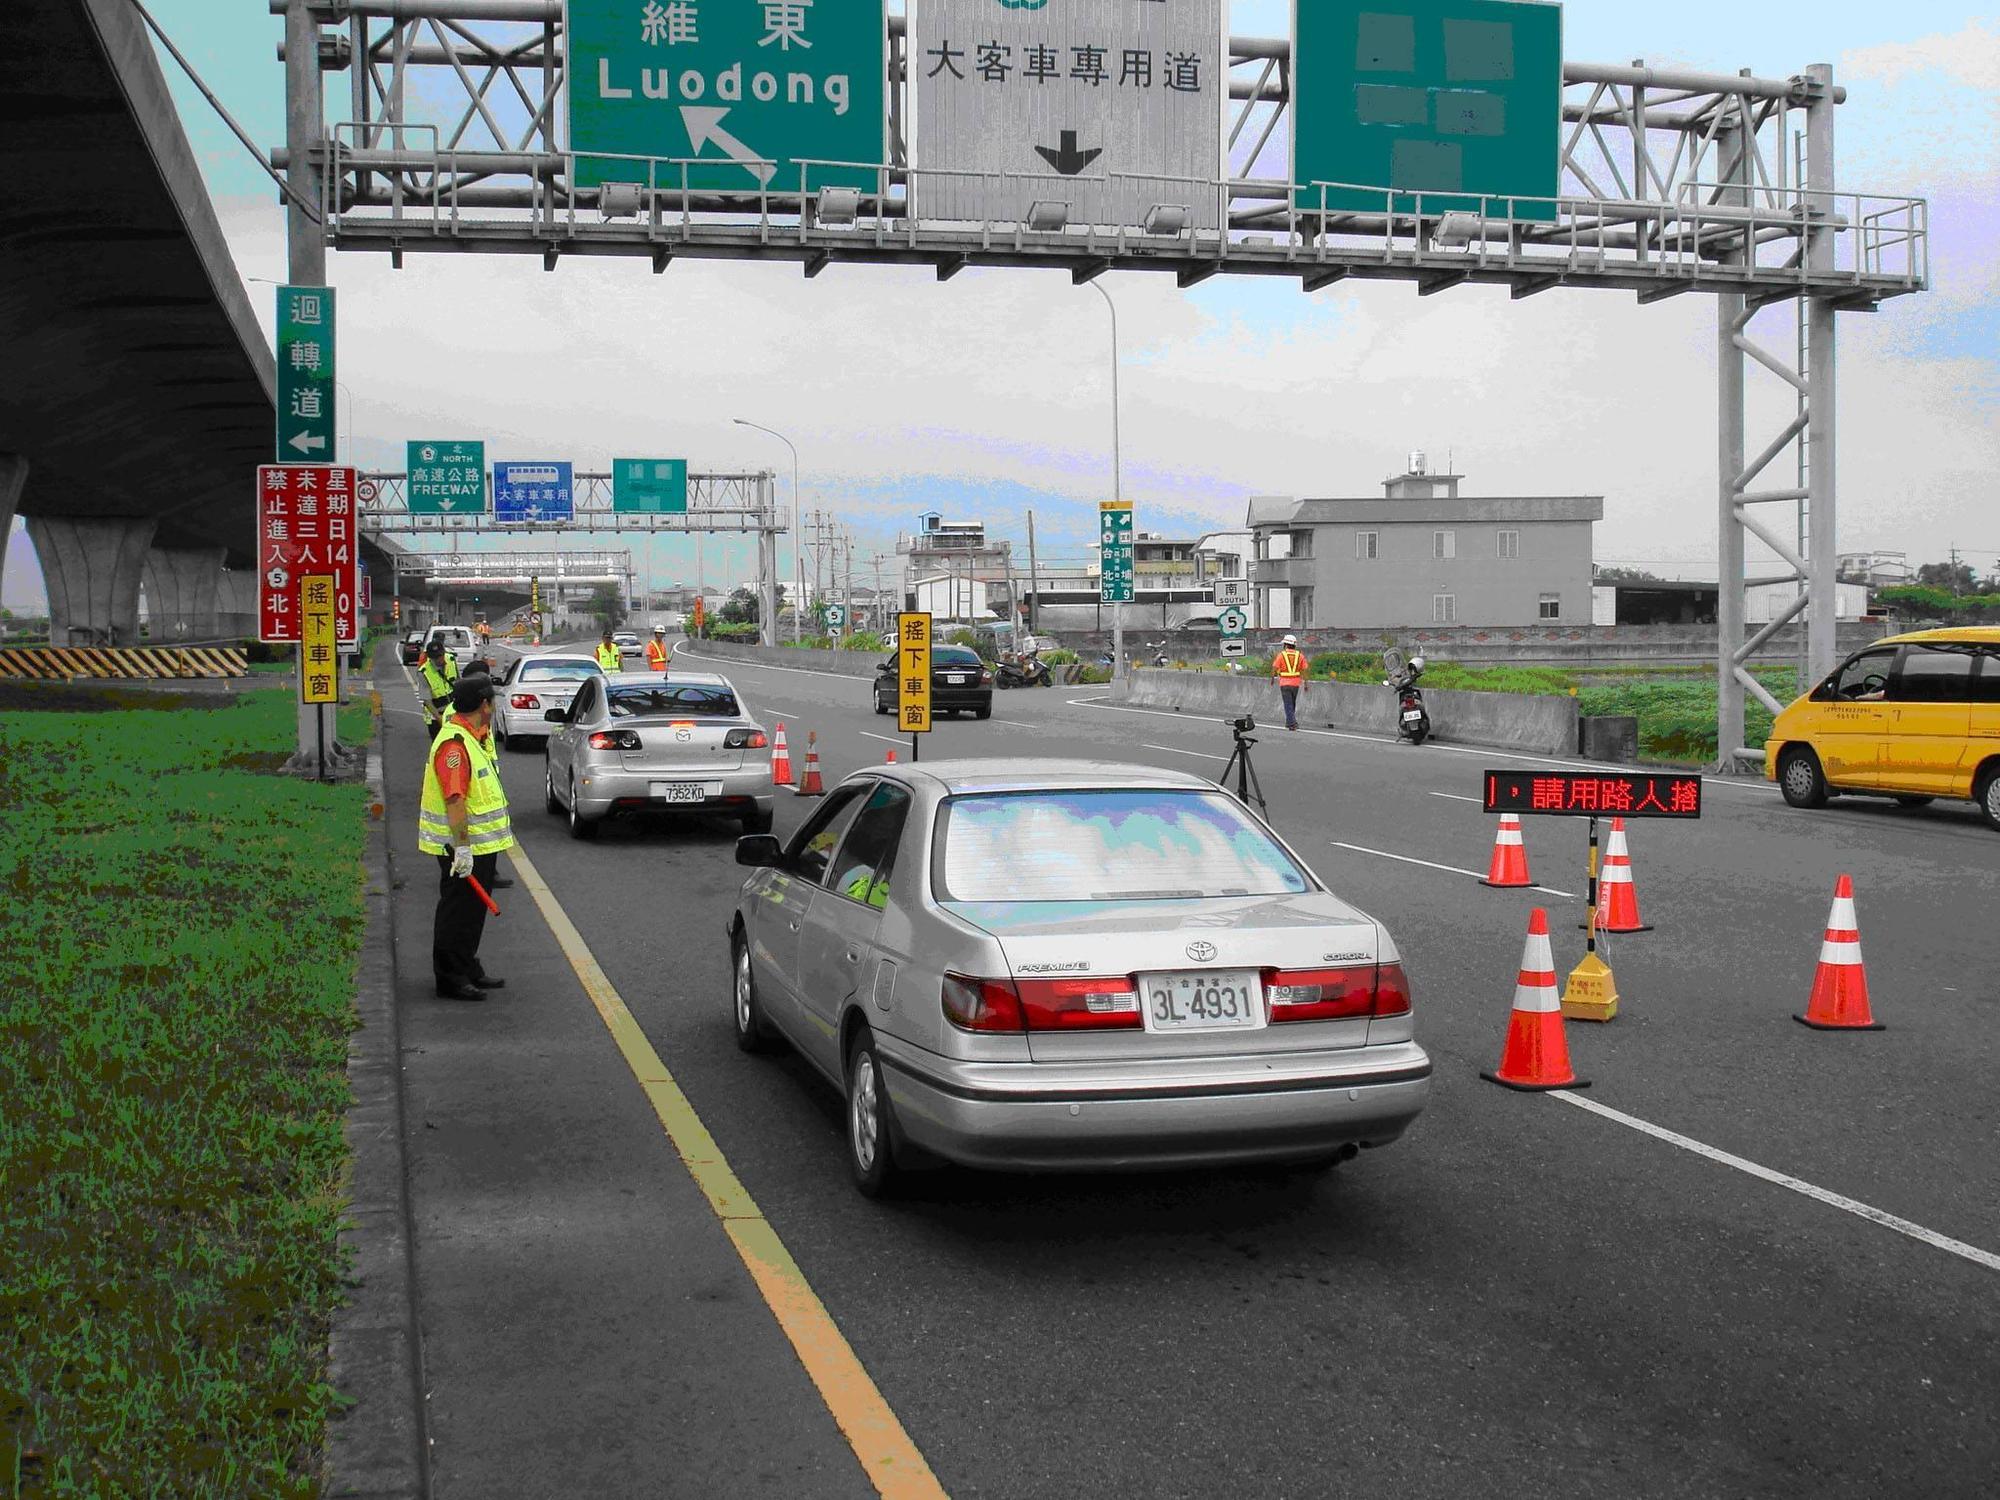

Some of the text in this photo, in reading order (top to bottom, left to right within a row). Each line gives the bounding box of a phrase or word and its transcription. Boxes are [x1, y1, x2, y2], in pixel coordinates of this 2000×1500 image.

[926, 39, 1202, 93] 大客車專用道
[598, 57, 850, 116] Luodong
[291, 294, 323, 419] 迴轉道
[442, 455, 474, 464] NORTH
[413, 467, 479, 482] 高速公路
[360, 486, 373, 496] 40
[413, 484, 480, 495] FREEWAY
[499, 488, 569, 501] 大客車專用
[1103, 589, 1131, 600] 37 9
[1225, 582, 1238, 596] 南
[1219, 596, 1245, 604] SOUTH
[1228, 616, 1238, 629] 5
[307, 582, 331, 696] 搖下車窗
[904, 620, 925, 725] 搖下車窗
